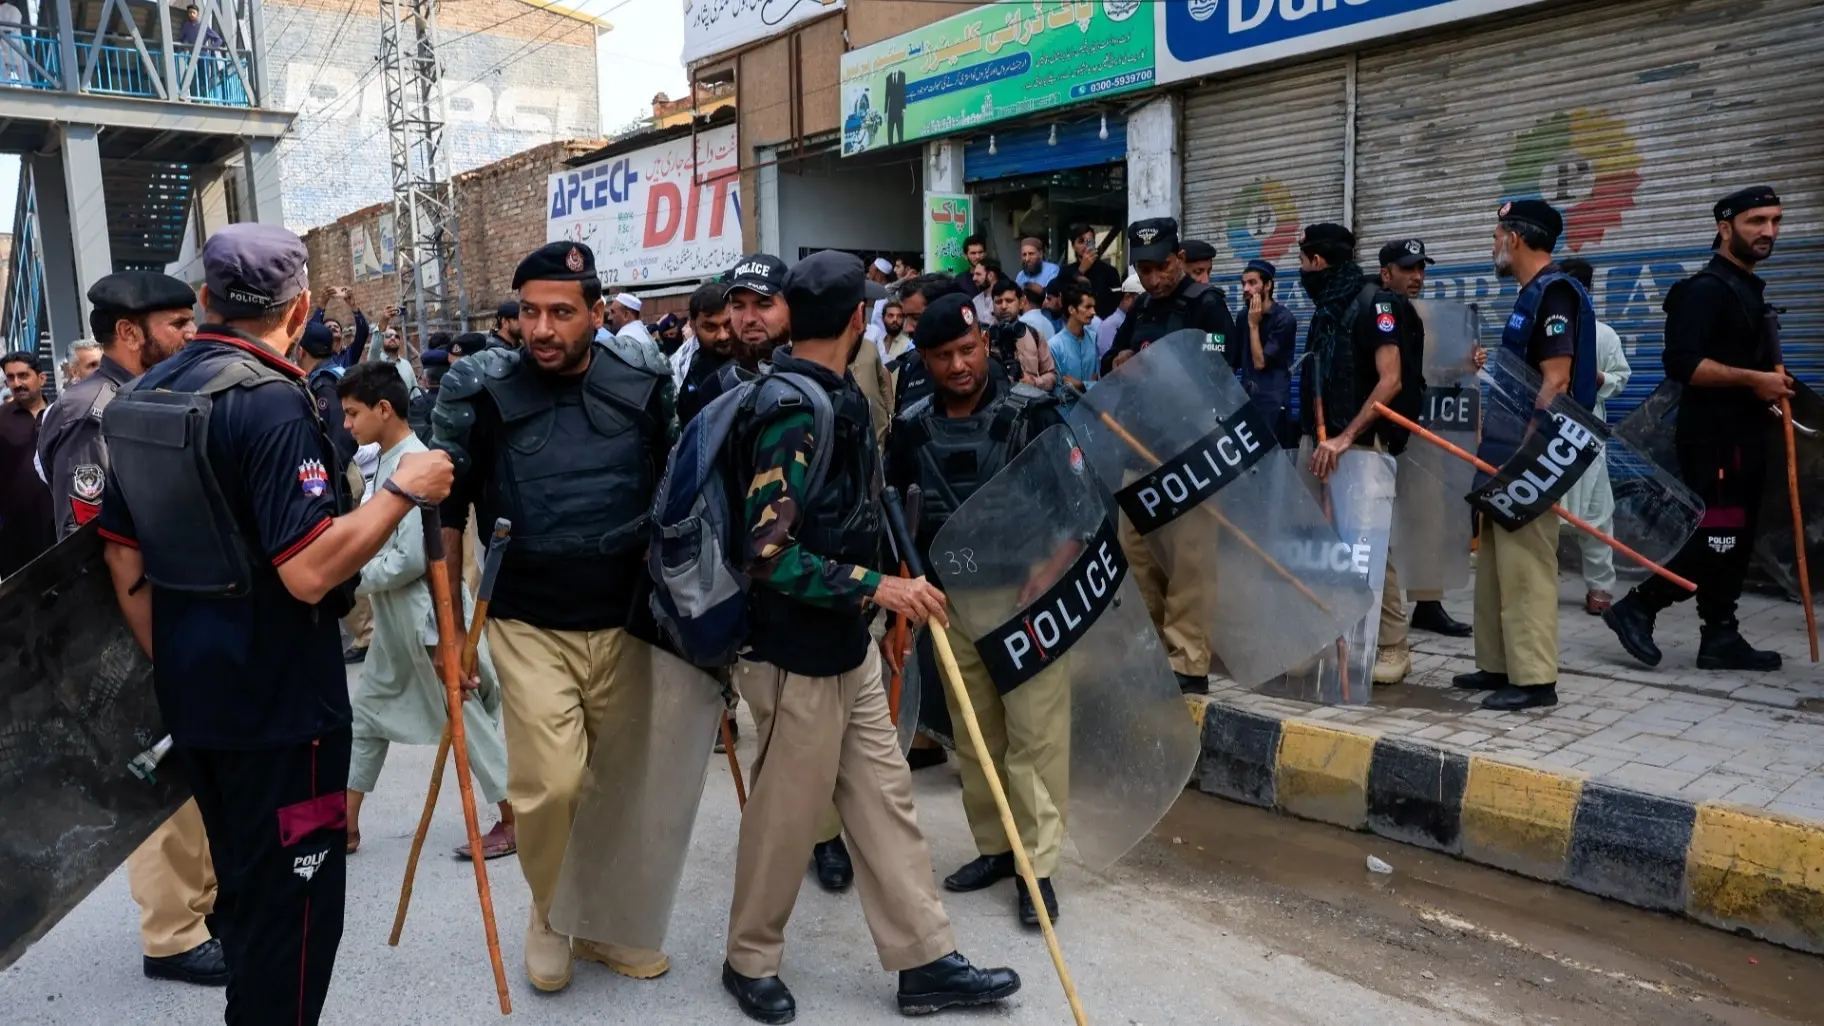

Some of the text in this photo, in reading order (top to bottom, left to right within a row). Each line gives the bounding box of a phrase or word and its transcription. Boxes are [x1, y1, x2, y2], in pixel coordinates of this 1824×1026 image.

[1090, 70, 1153, 92] 0300-5939700
[551, 158, 638, 219] APTECH
[643, 166, 740, 249] DIT
[734, 262, 771, 280] POLICE
[230, 292, 265, 305] POLICE
[1202, 343, 1226, 353] POLICE
[1137, 421, 1260, 518] POLICE
[1487, 414, 1592, 519] POLICE
[1708, 536, 1737, 545] POLICE
[944, 547, 978, 575] 38
[1003, 541, 1118, 670] POLICE
